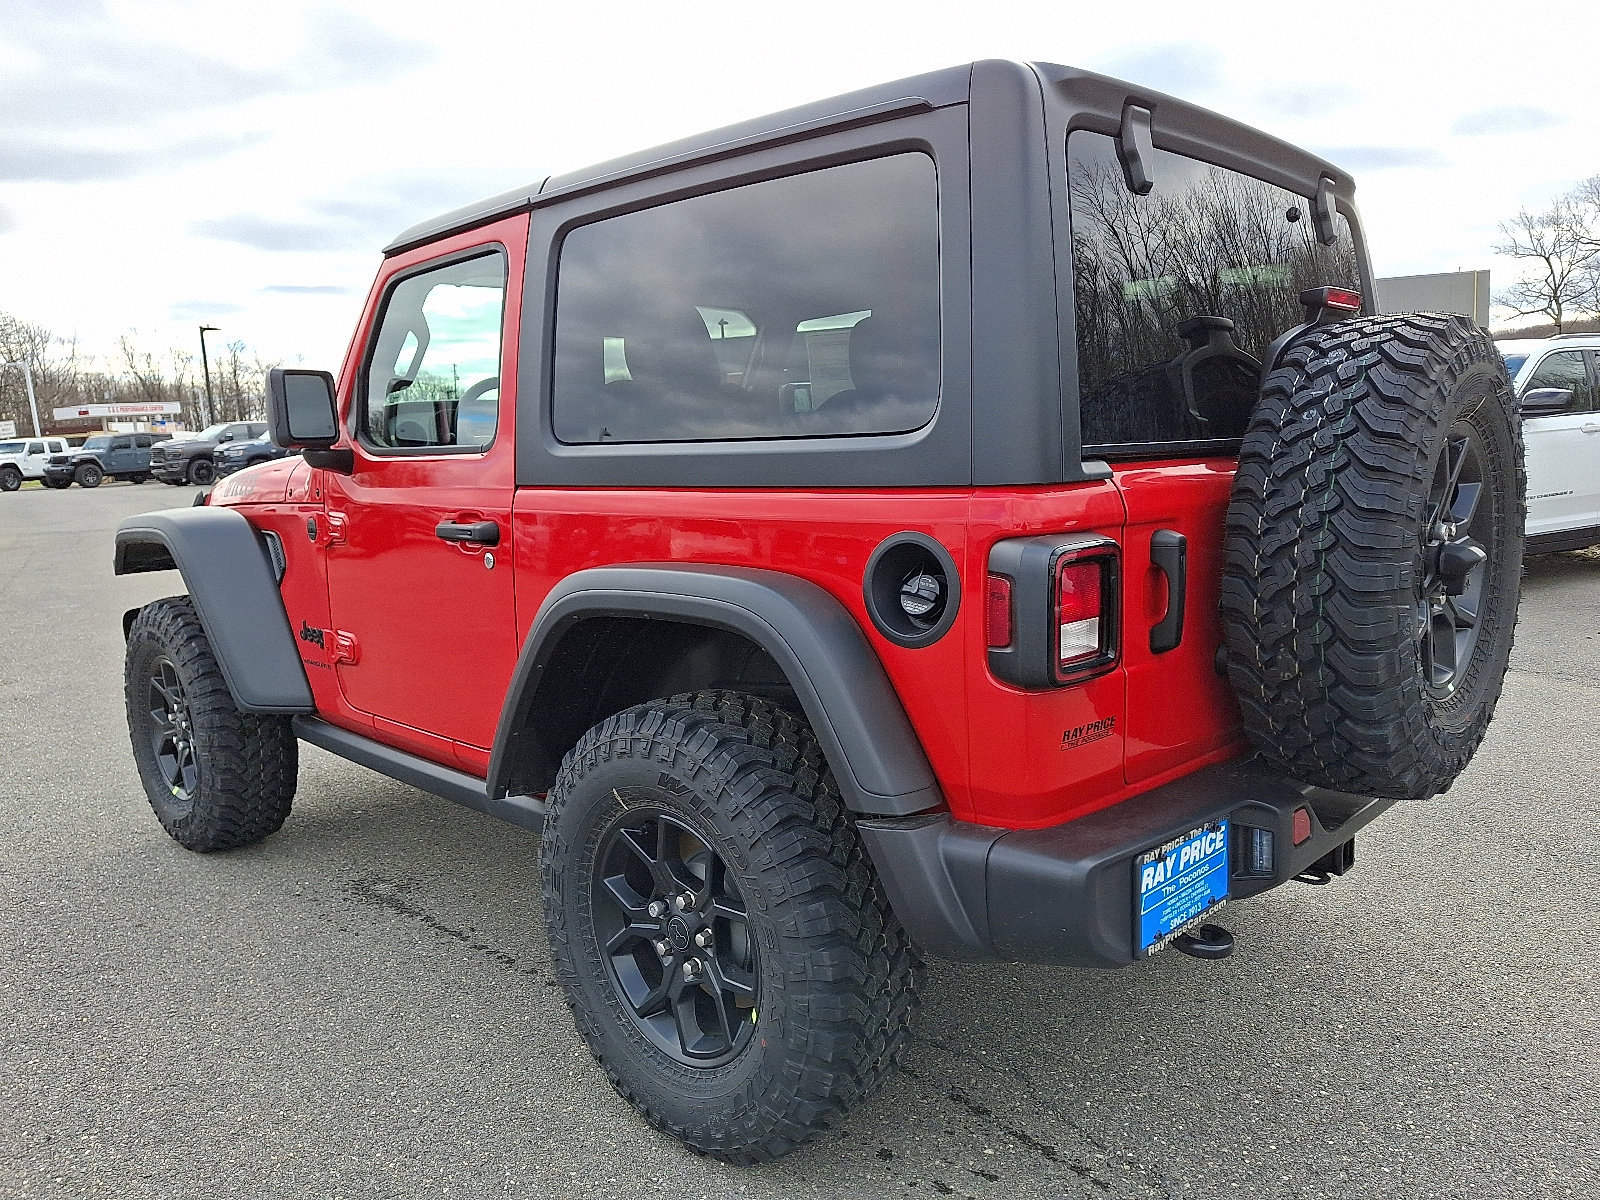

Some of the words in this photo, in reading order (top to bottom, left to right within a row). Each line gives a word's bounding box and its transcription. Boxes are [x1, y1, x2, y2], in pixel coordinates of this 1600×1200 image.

[300, 620, 324, 649] Jeep
[1062, 724, 1086, 743] RAY
[1086, 715, 1116, 736] PRICE
[1141, 853, 1177, 893] RAY
[1179, 825, 1225, 871] PRICE
[1144, 848, 1161, 864] RAY
[1161, 835, 1185, 855] PRICE
[1189, 827, 1203, 839] The
[1162, 884, 1176, 897] The
[1179, 864, 1210, 887] Poconos
[1147, 899, 1228, 956] RayPriceCars.com
[1170, 911, 1188, 930] SINCE
